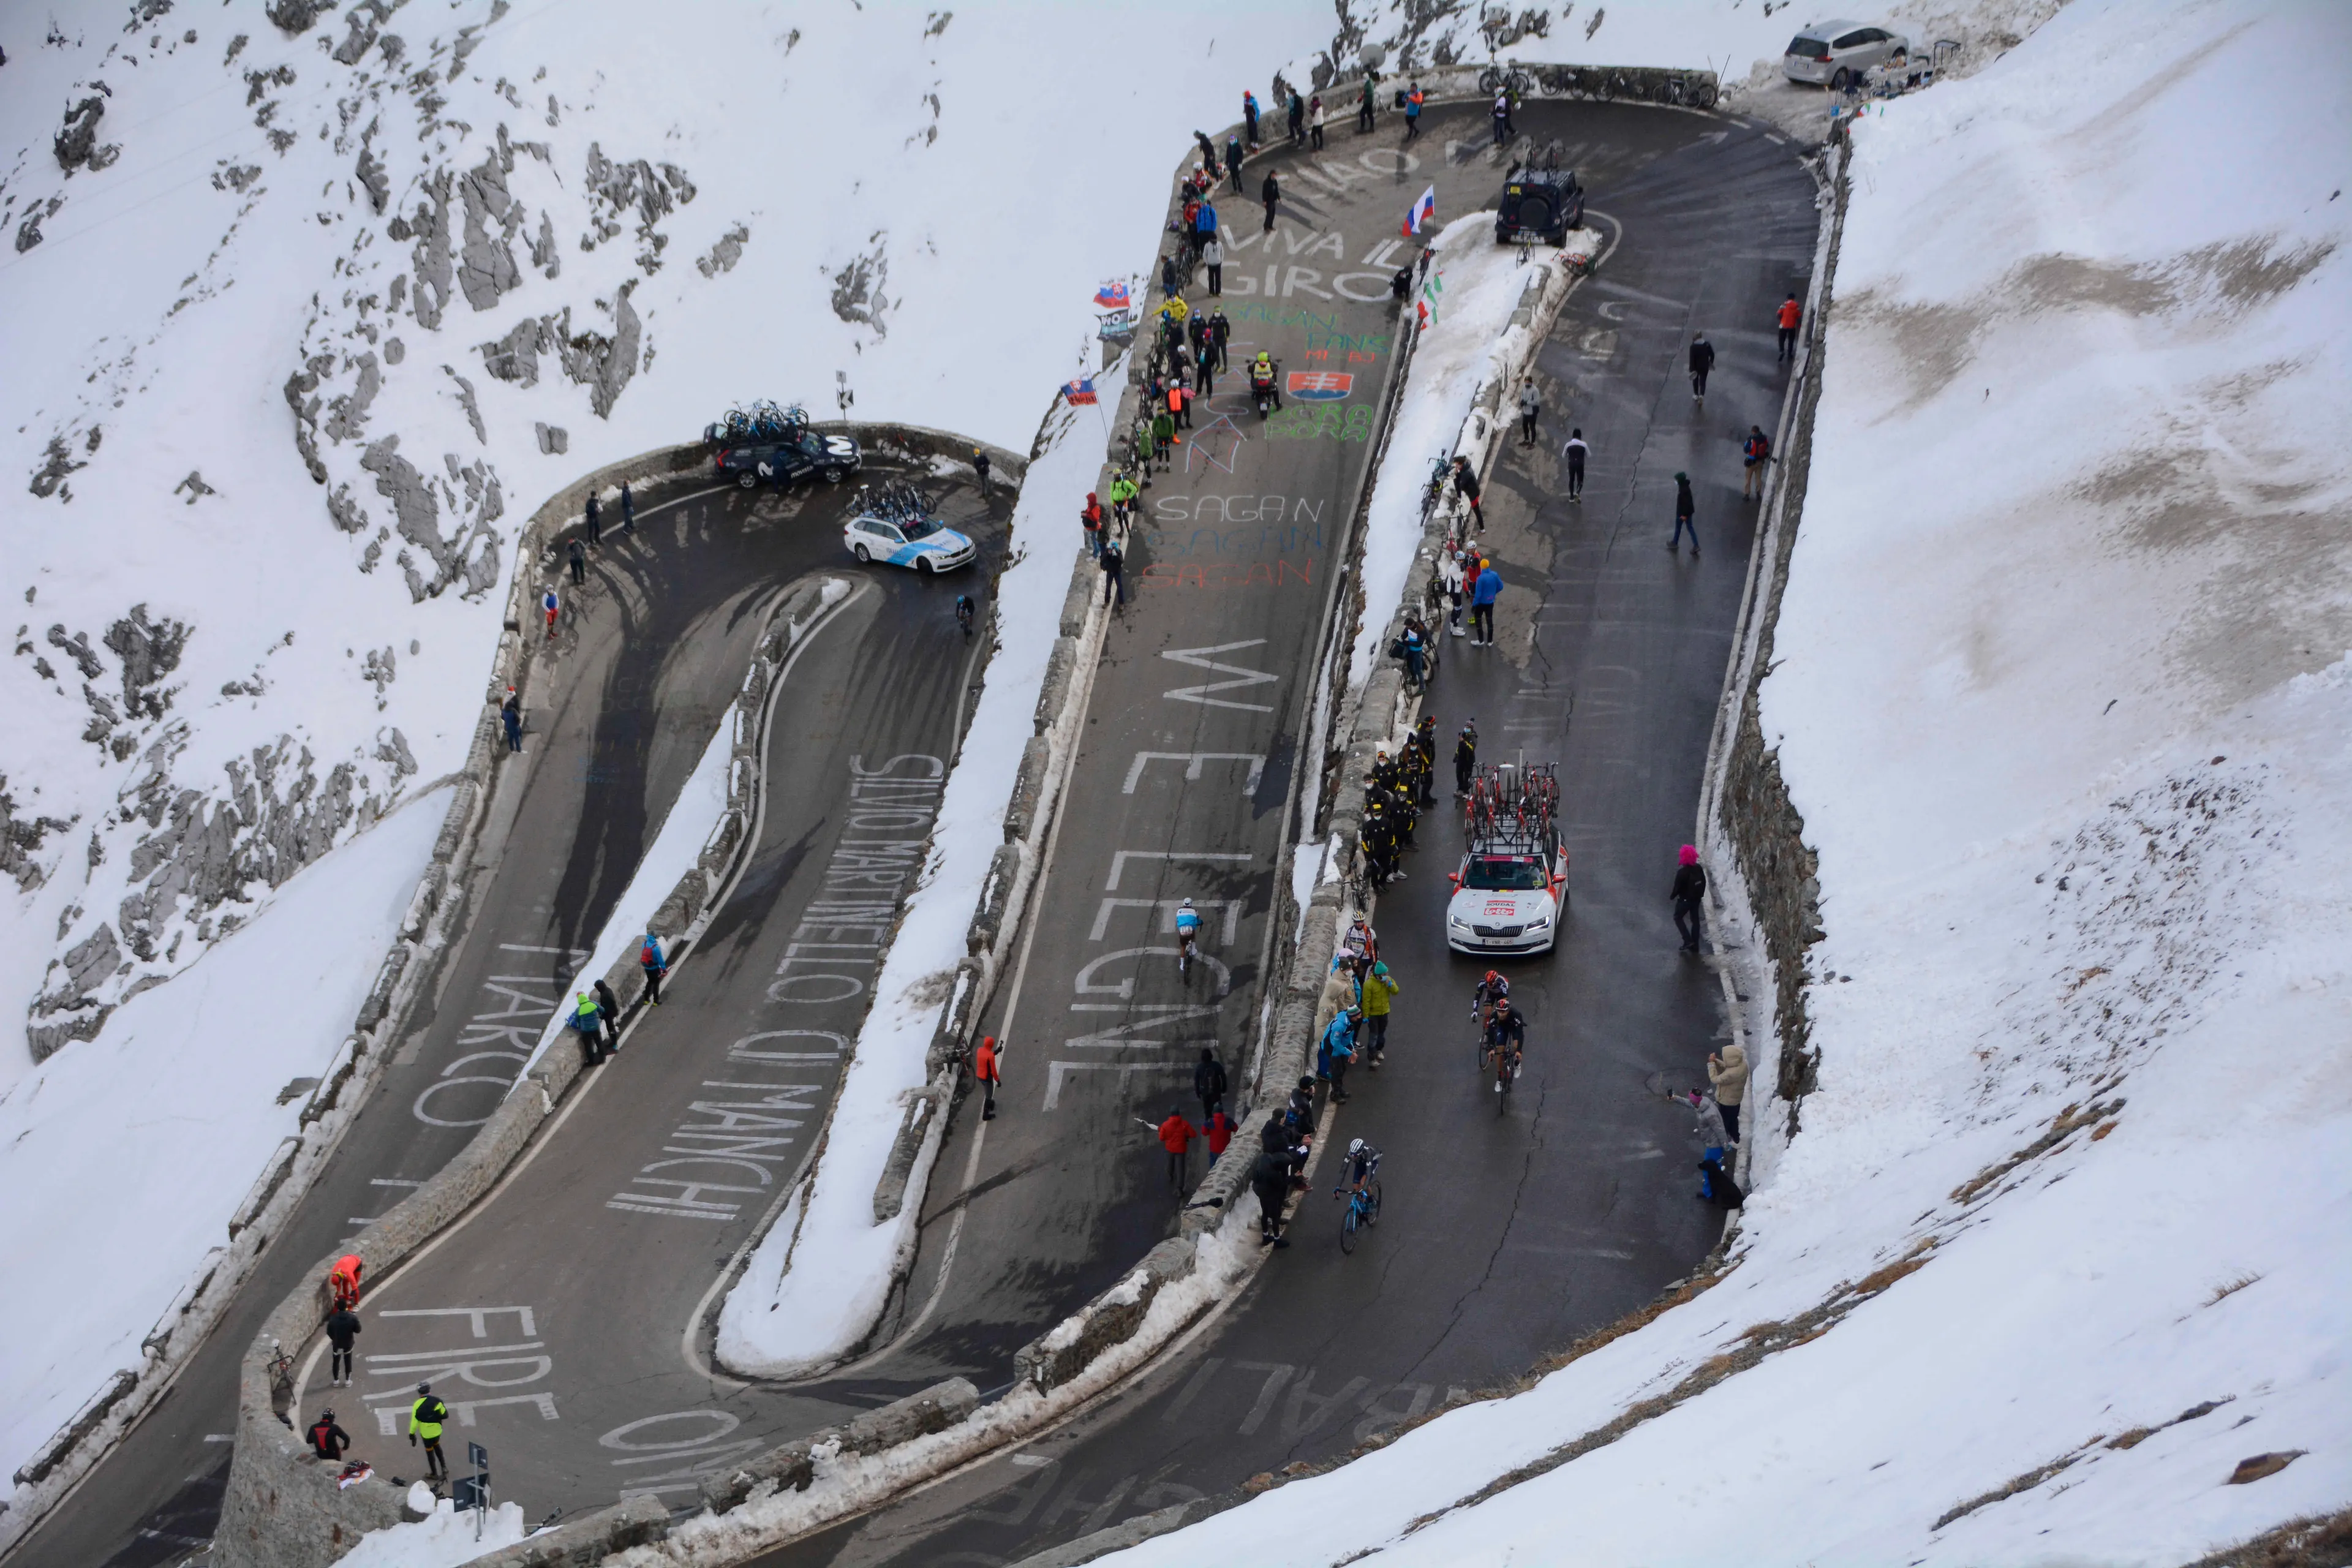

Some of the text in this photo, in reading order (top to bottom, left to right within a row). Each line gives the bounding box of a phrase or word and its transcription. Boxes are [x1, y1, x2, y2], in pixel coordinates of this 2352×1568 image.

[1221, 224, 1406, 270] VIVA IL
[1197, 260, 1395, 302] GIRO
[1307, 332, 1392, 355] FANS
[1155, 495, 1323, 522] SAGAN
[1148, 522, 1322, 556] SAGAN
[1141, 558, 1313, 588] SAGAN
[849, 754, 944, 830] SILVIO
[764, 839, 924, 1003] MARTINELLO
[413, 943, 590, 1127] MARCO
[605, 1080, 822, 1221] MANCHI
